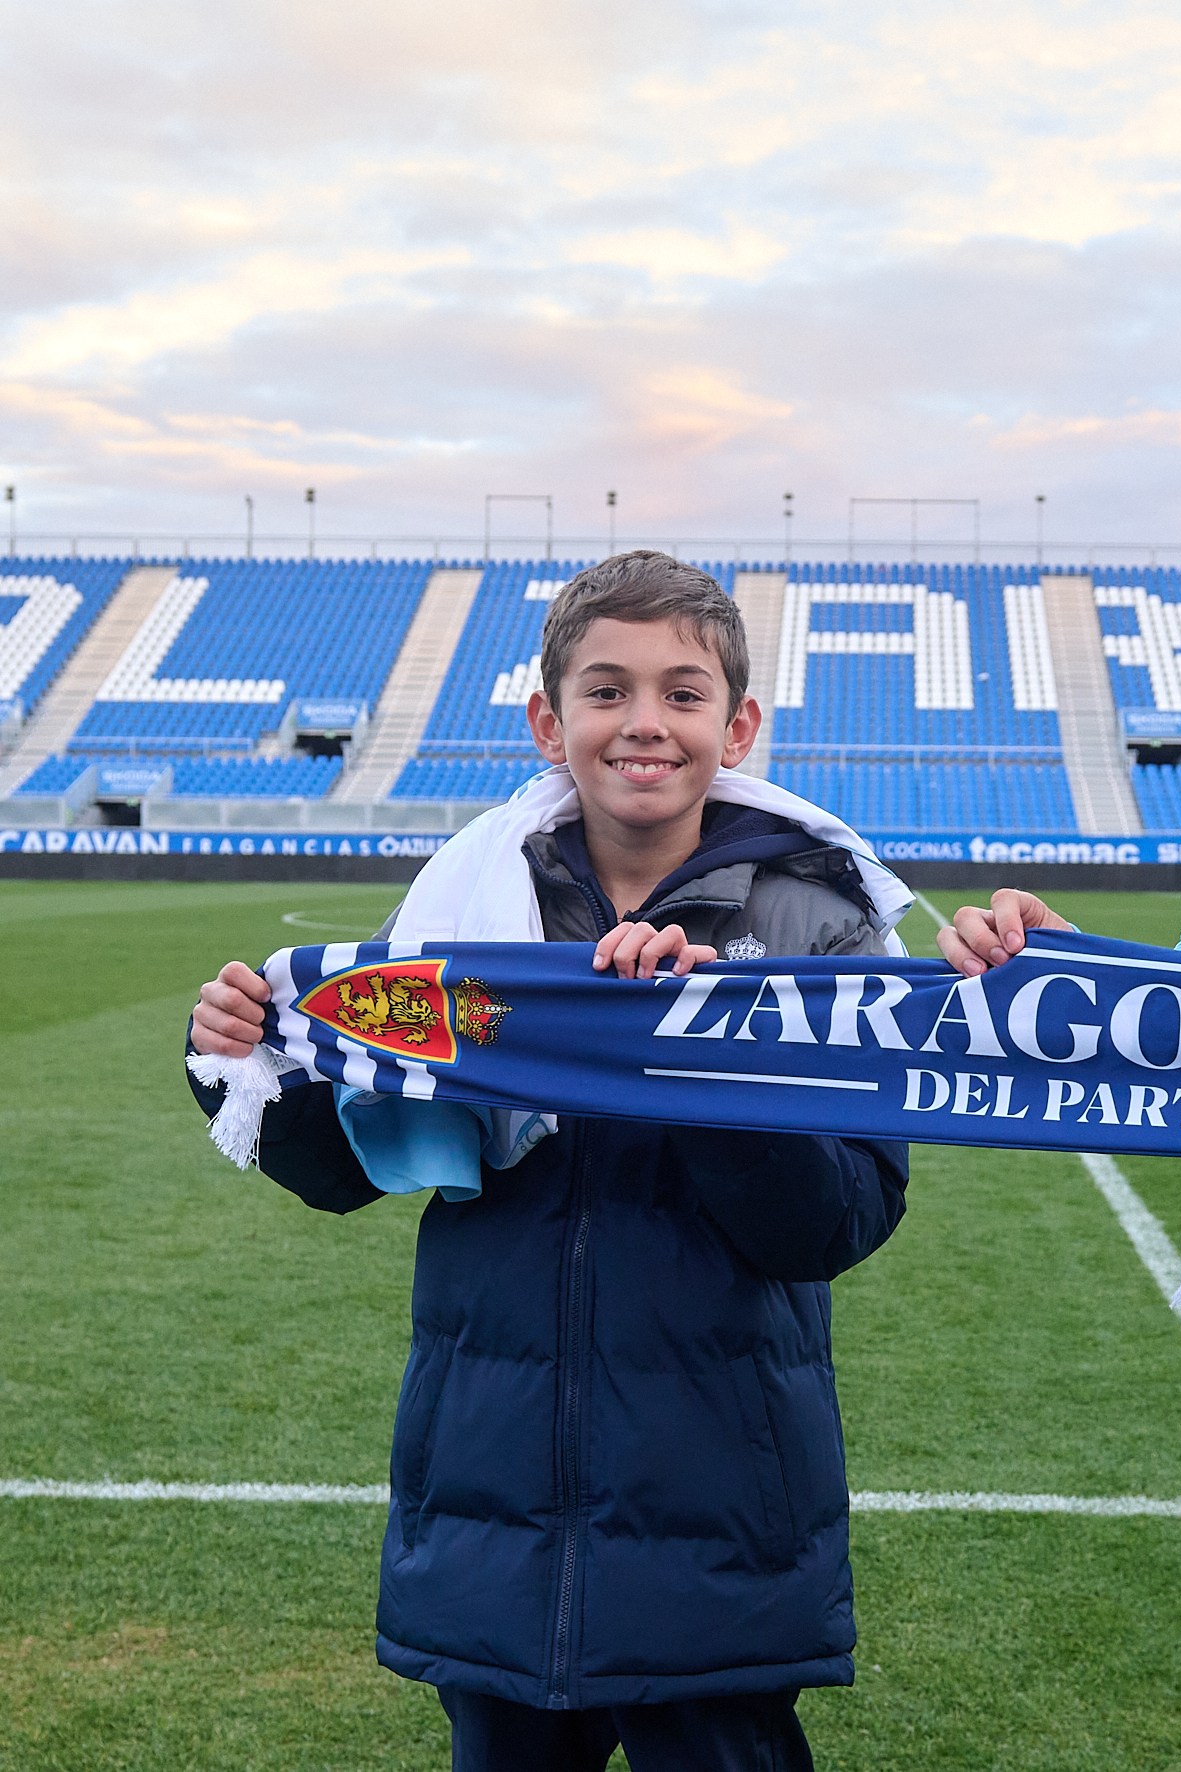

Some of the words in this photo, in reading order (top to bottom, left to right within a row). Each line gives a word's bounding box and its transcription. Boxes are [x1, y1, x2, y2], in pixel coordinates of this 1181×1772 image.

[182, 837, 372, 857] FRAGANCIAS
[883, 841, 963, 860] COCINAS
[969, 836, 1141, 863] tecemac
[902, 1068, 1029, 1119] DEL
